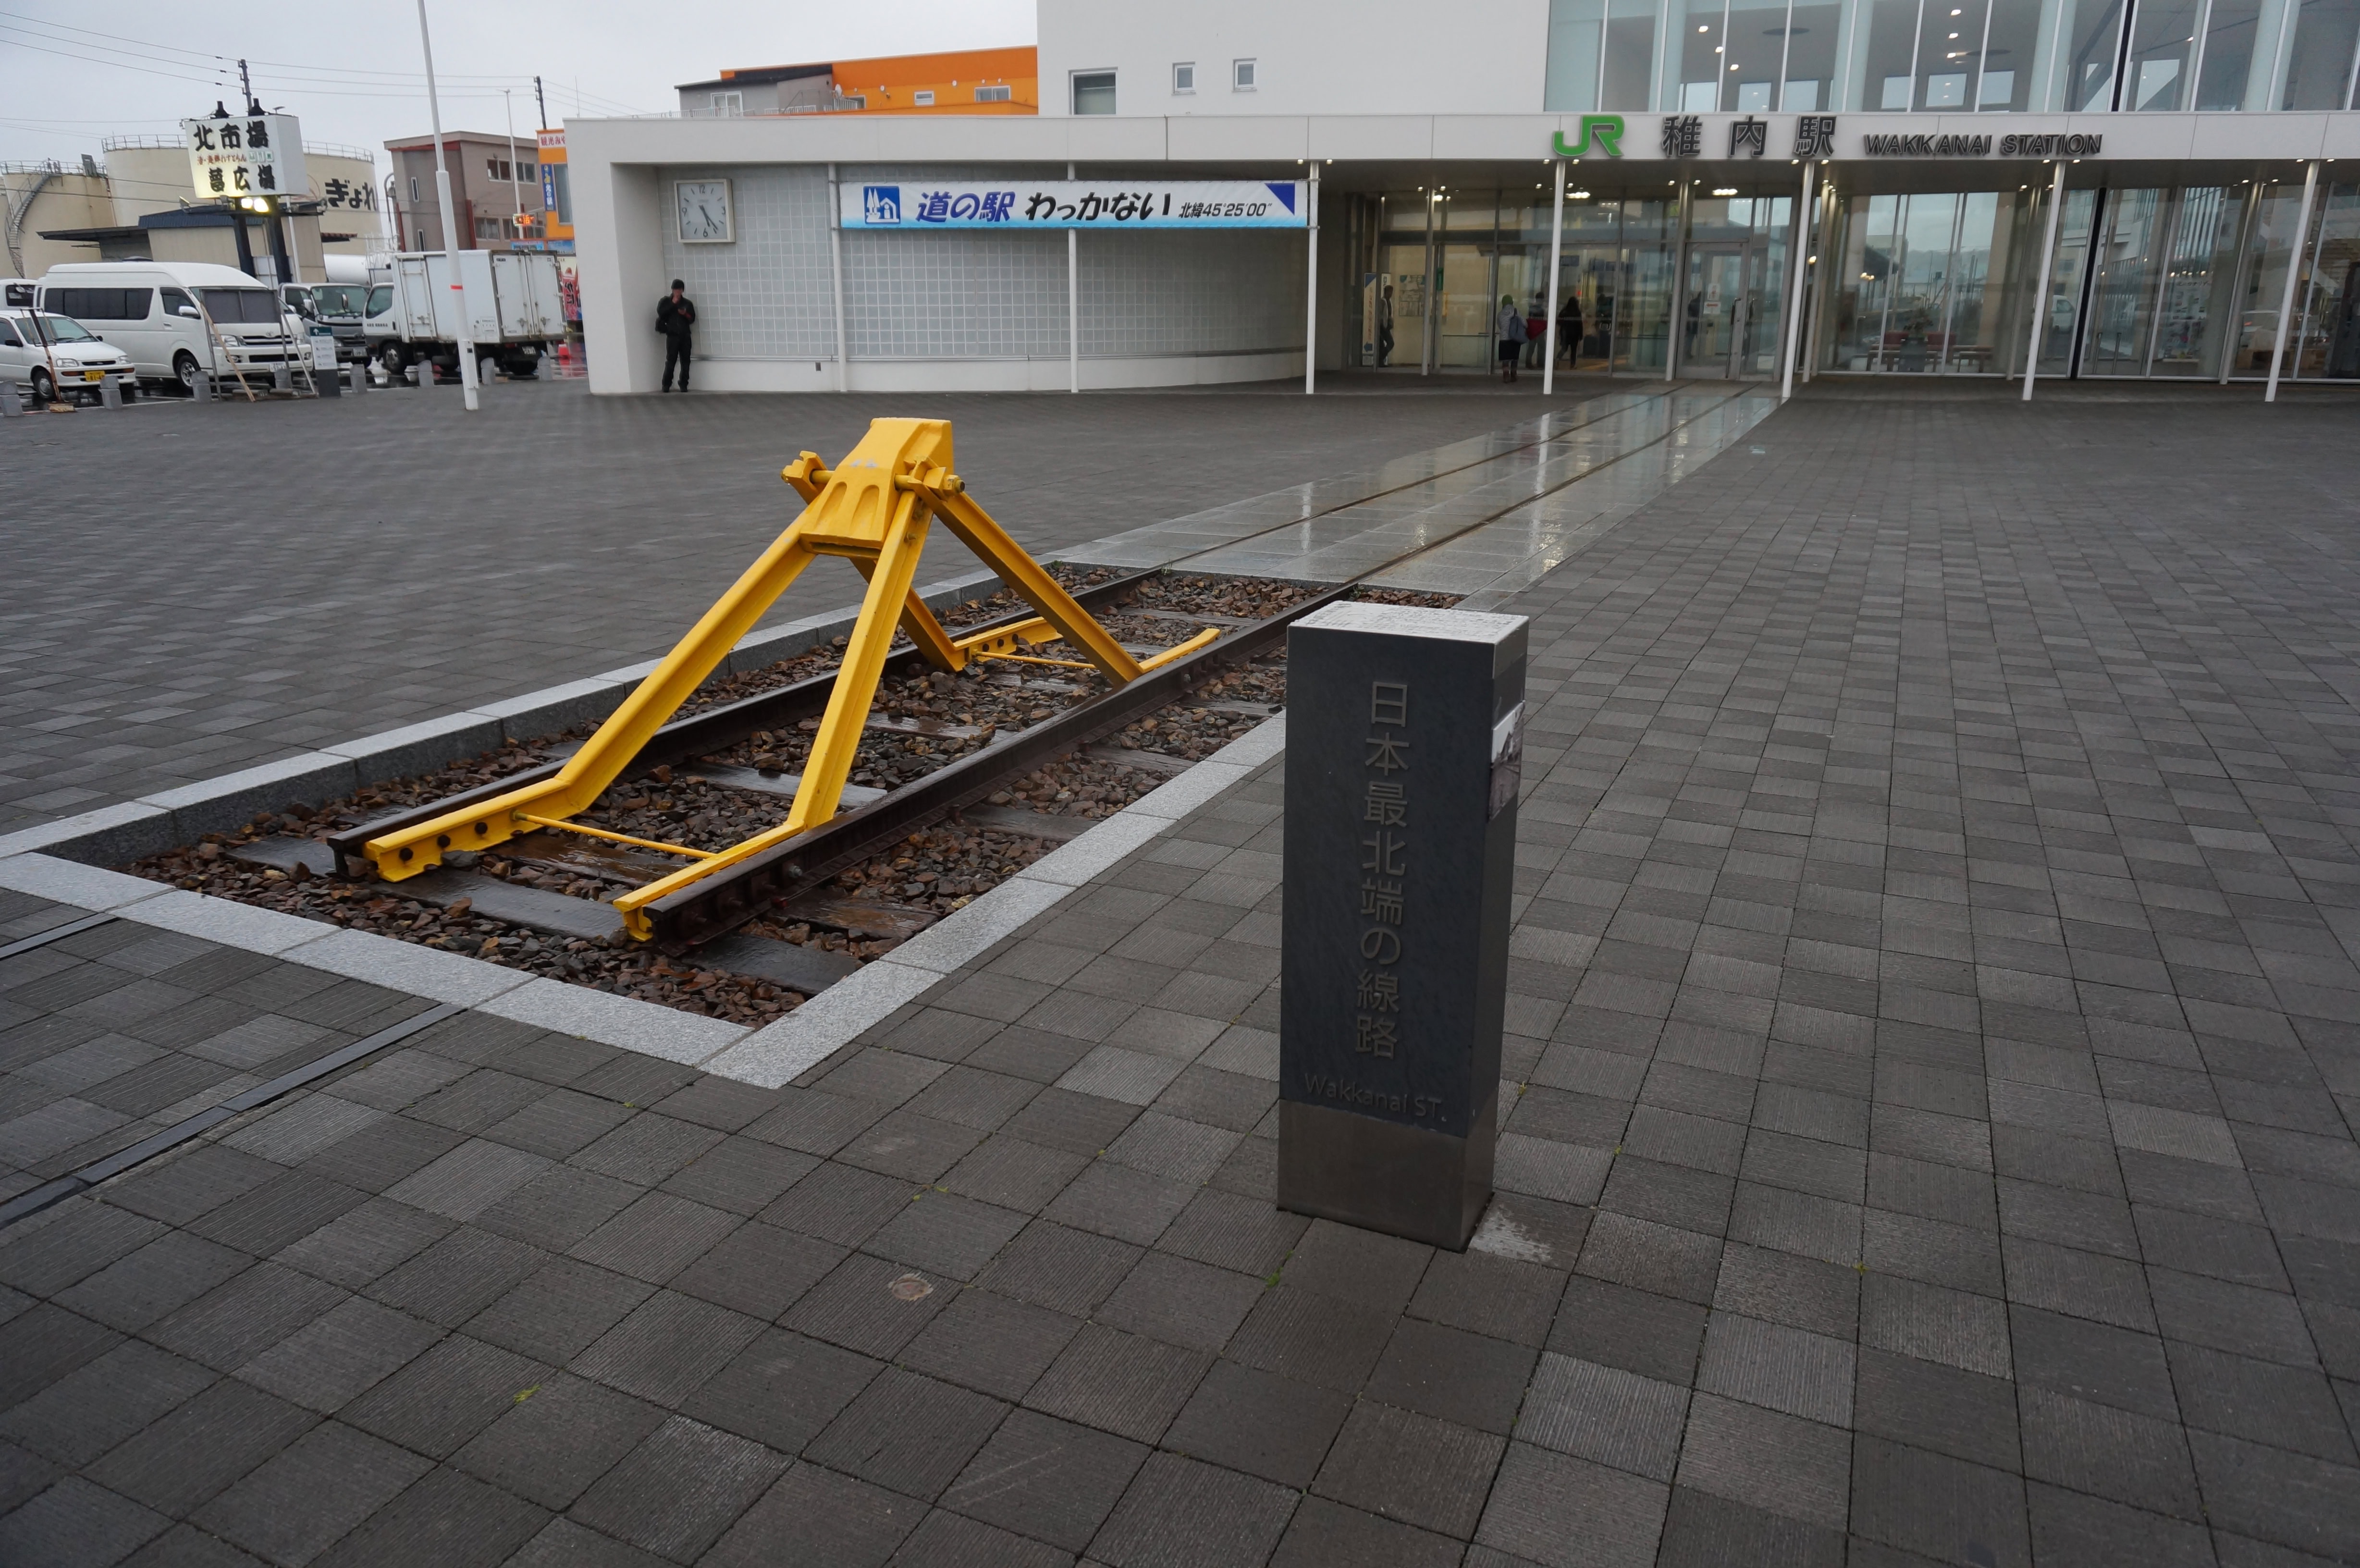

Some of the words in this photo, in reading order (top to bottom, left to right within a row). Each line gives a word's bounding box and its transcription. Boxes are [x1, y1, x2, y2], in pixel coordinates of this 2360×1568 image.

[193, 120, 269, 152] 北市場
[1553, 114, 1624, 156] JR
[1661, 115, 1837, 157] 稚内駅
[1863, 134, 1992, 156] WAKKANAI
[2001, 134, 2103, 156] STATION
[699, 184, 705, 194] 12
[682, 207, 687, 216] 9
[721, 206, 726, 215] 3
[915, 190, 1016, 223] 道の駅
[1024, 192, 1171, 221] わっかない
[703, 228, 708, 237] 6
[1355, 681, 1410, 1060] 日本最北端の線路
